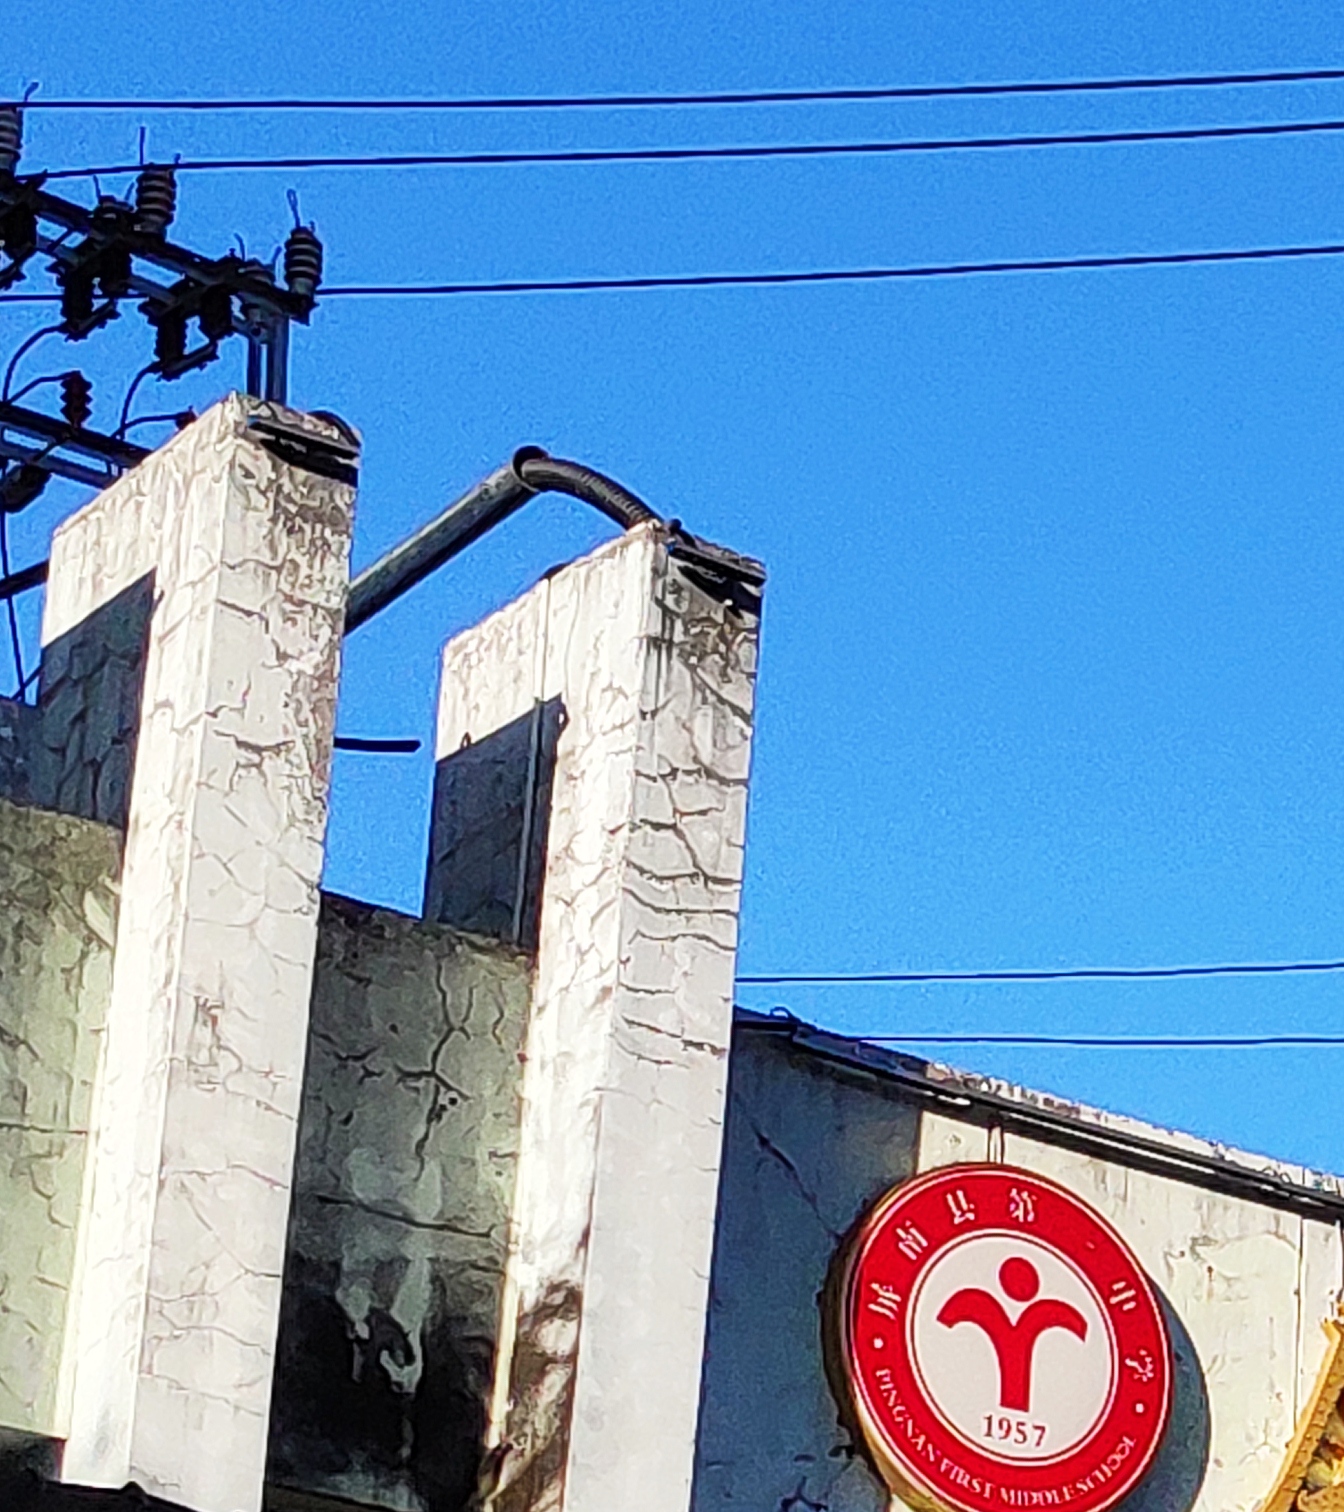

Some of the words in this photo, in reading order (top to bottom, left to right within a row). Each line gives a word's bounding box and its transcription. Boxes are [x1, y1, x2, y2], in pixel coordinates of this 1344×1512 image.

[982, 1412, 1048, 1449] 1957
[940, 1456, 997, 1499] FIRST
[1000, 1482, 1076, 1508] MIDDLE
